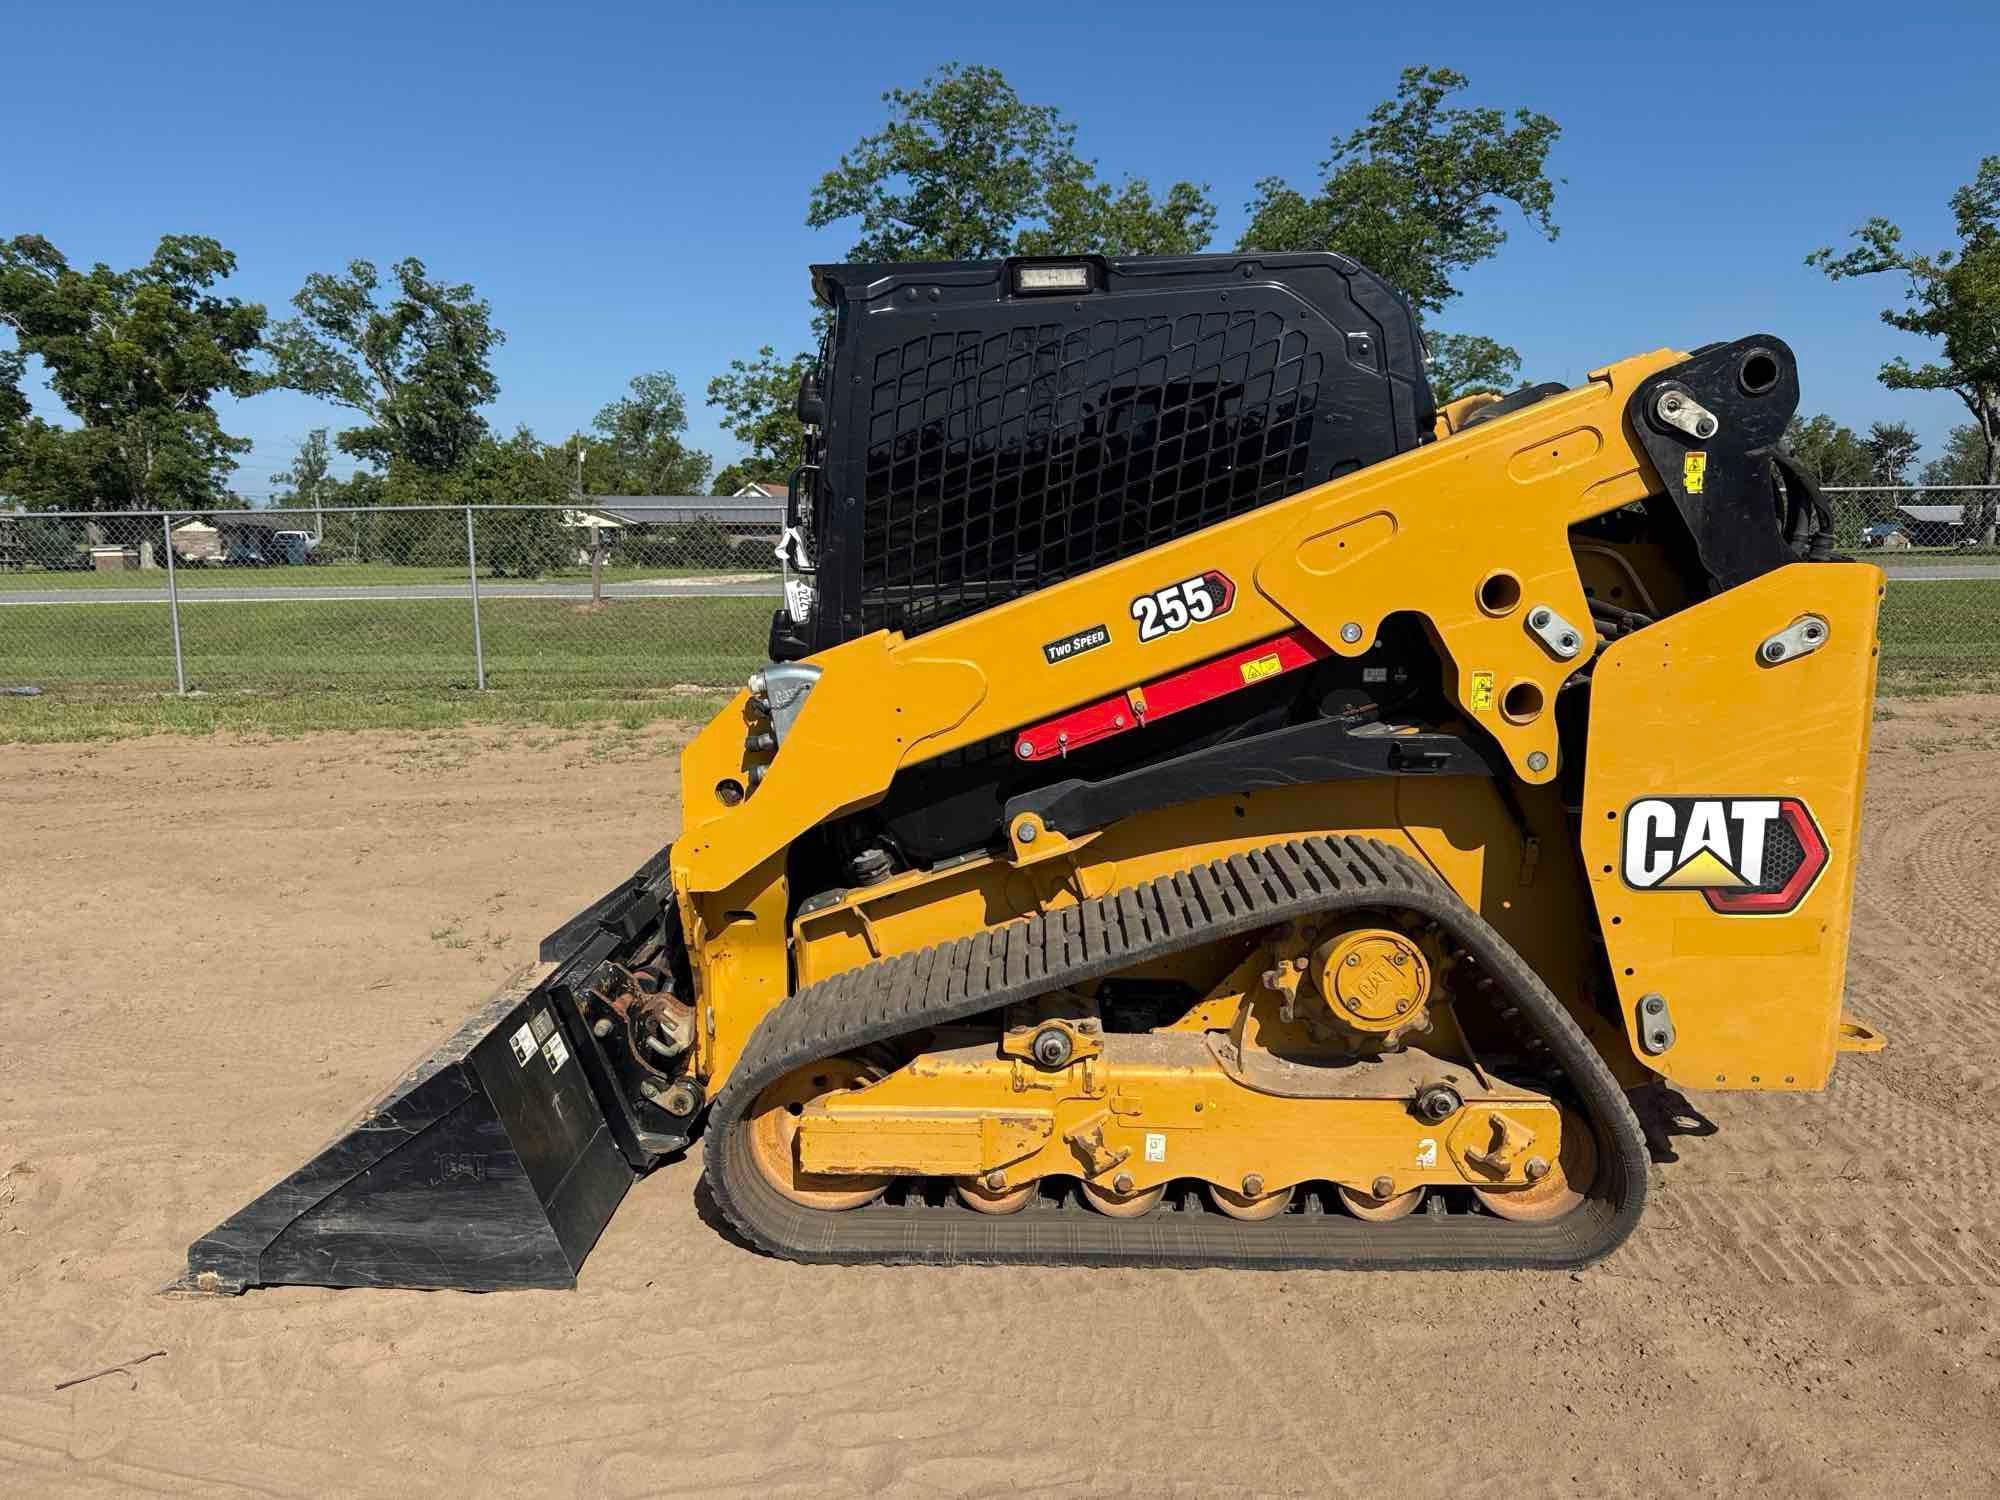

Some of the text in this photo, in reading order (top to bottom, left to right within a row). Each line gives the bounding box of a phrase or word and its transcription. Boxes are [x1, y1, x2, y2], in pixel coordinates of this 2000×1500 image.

[1132, 576, 1214, 641] 255
[1626, 799, 1780, 887] CAT
[1359, 968, 1392, 999] CAT
